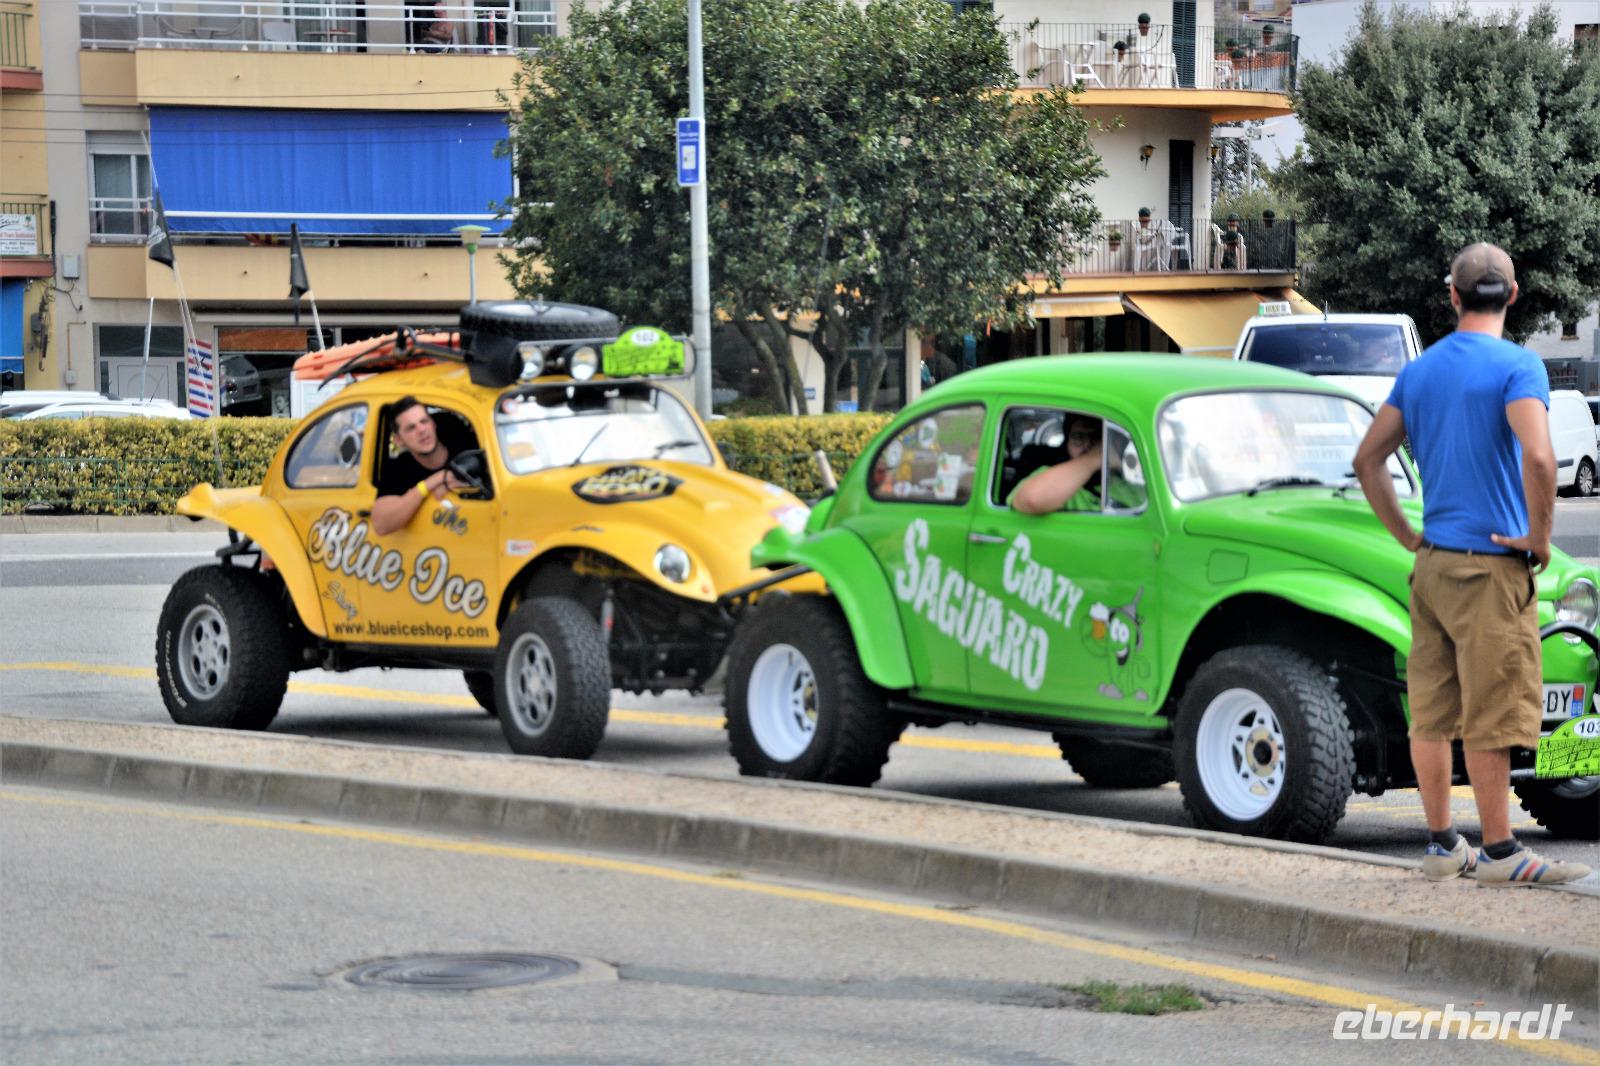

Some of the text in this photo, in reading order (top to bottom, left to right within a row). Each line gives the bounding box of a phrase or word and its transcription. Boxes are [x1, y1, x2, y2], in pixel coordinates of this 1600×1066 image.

[308, 506, 488, 619] Blue Ice
[1003, 533, 1083, 629] CRAZY
[333, 621, 489, 640] www.blueiceshop.com
